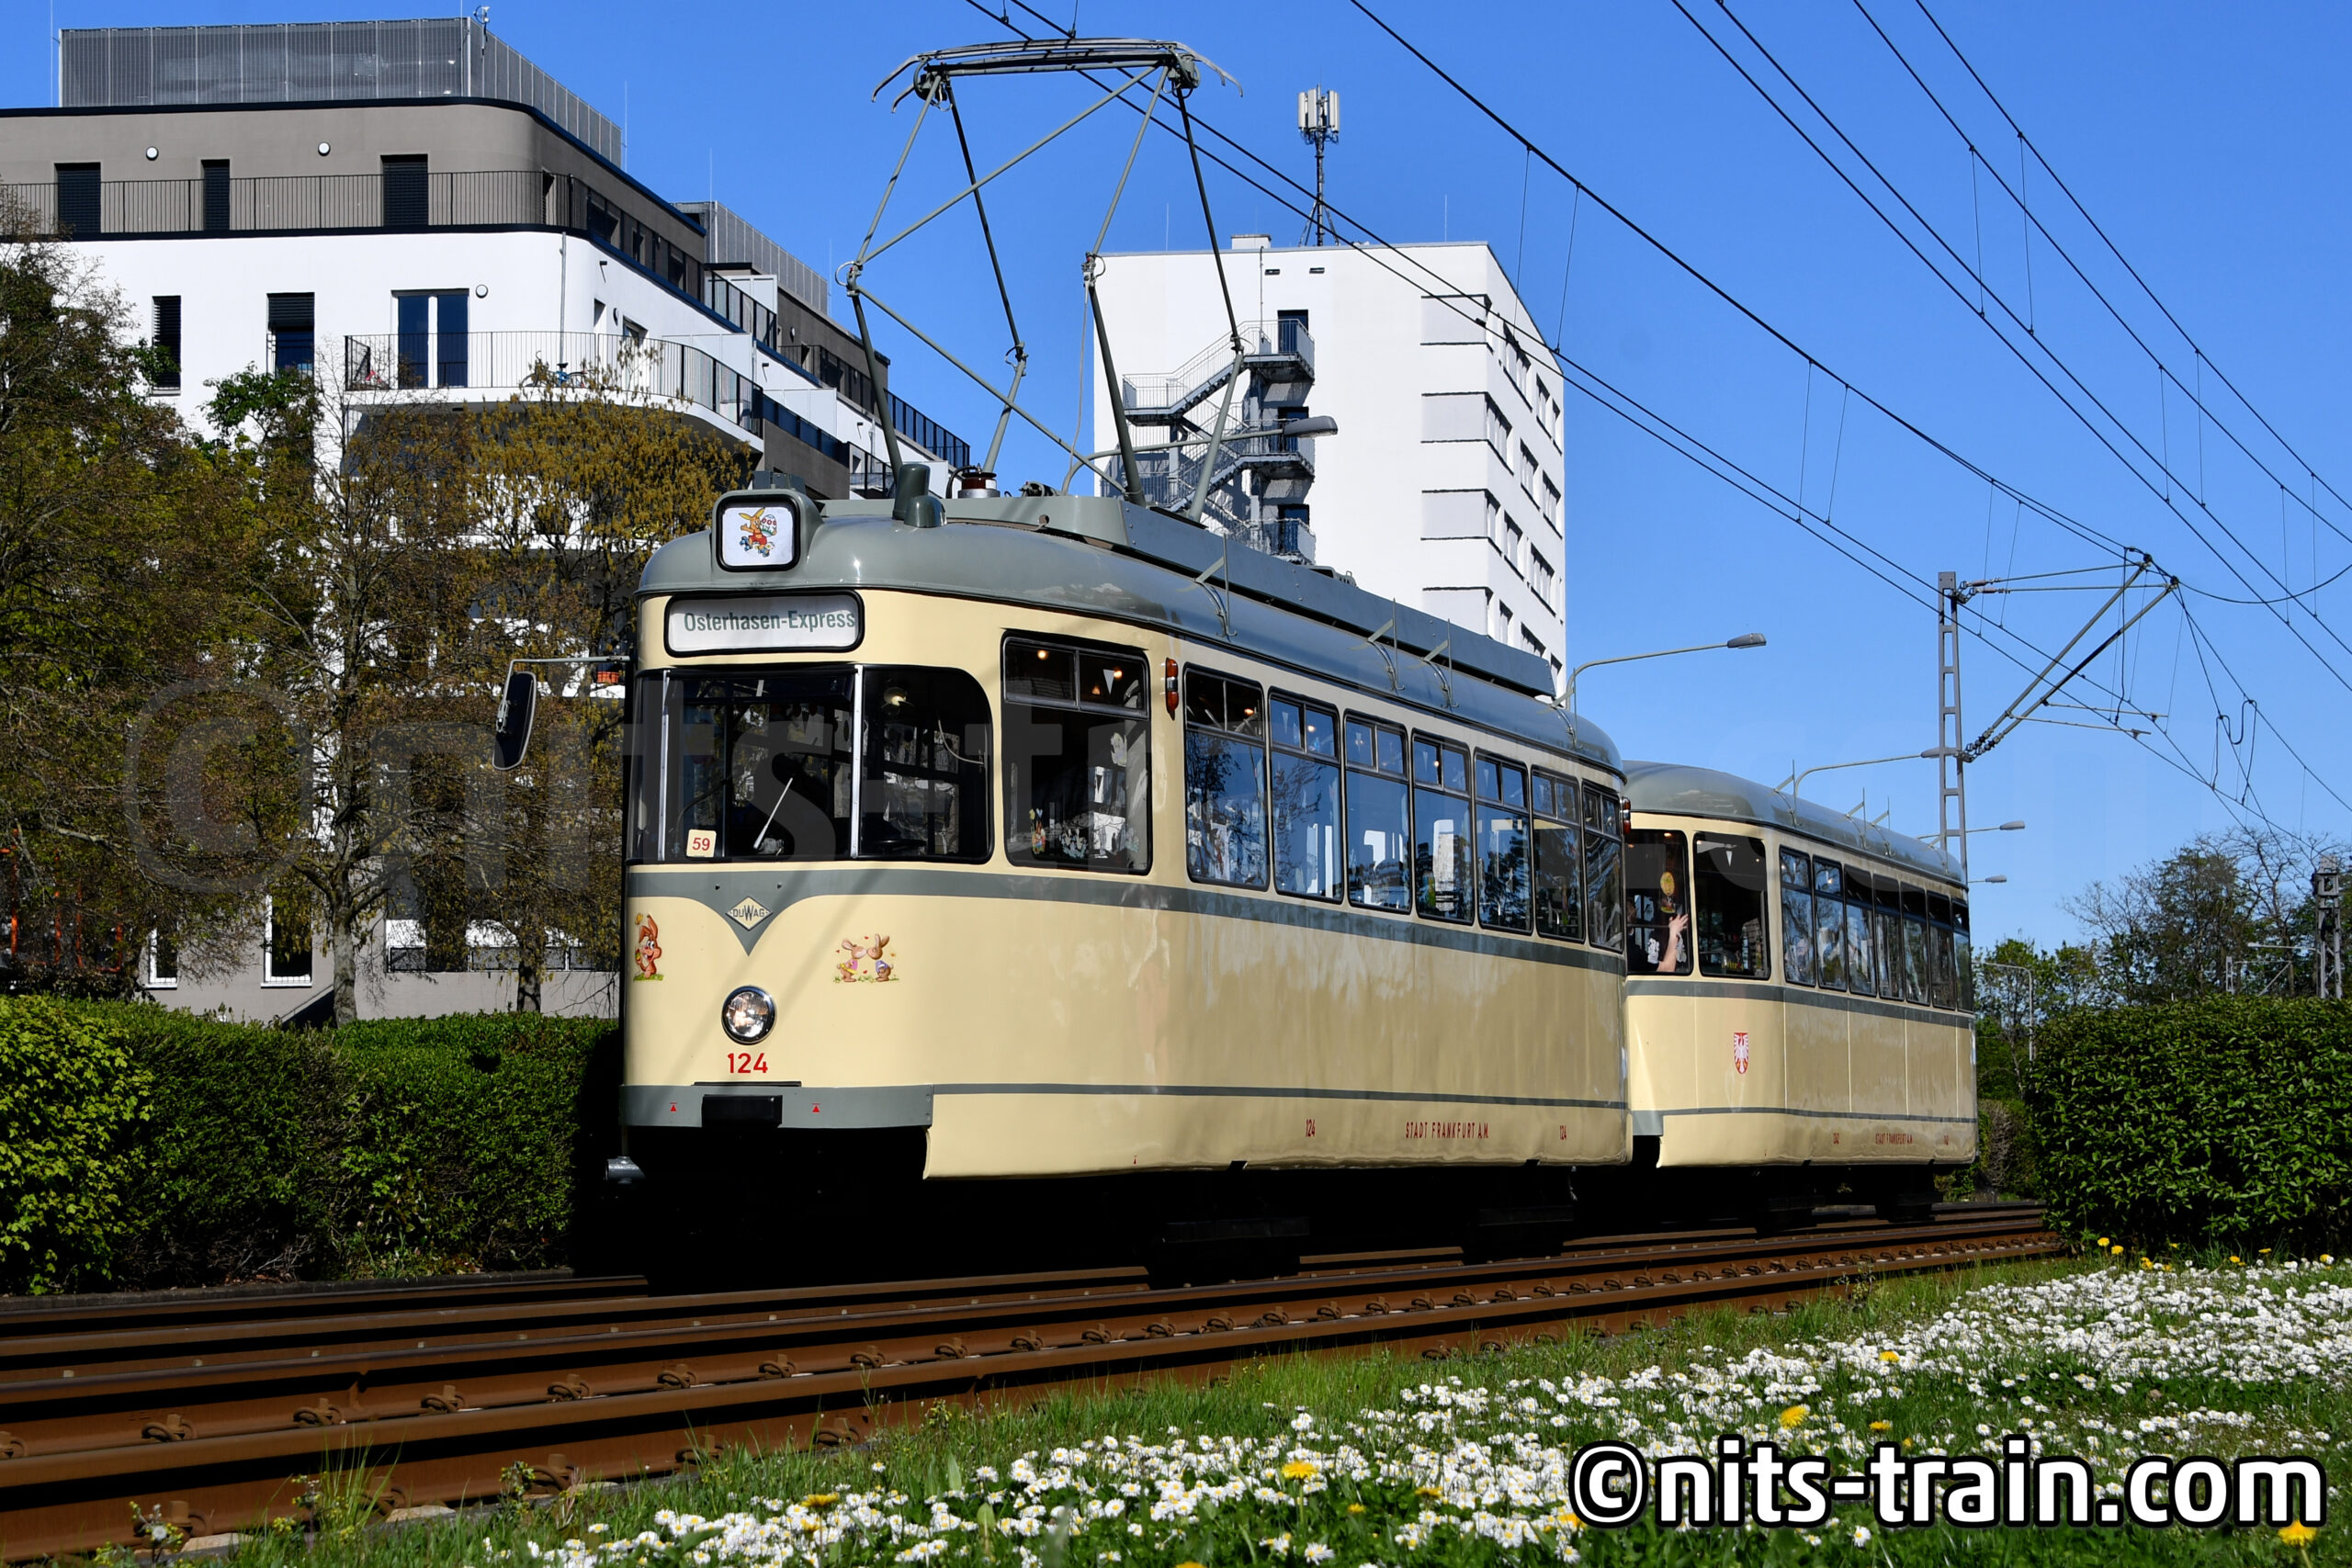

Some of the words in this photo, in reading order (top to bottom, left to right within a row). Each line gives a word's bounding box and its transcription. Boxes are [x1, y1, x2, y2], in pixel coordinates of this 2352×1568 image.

[684, 610, 855, 633] Osterhasen-Express
[692, 837, 710, 852] 59
[732, 905, 765, 921] DUWAG
[727, 1053, 769, 1074] 124
[1305, 1119, 1316, 1138] 124
[1405, 1122, 1429, 1139] STADT
[1431, 1122, 1476, 1139] FRANKFURT
